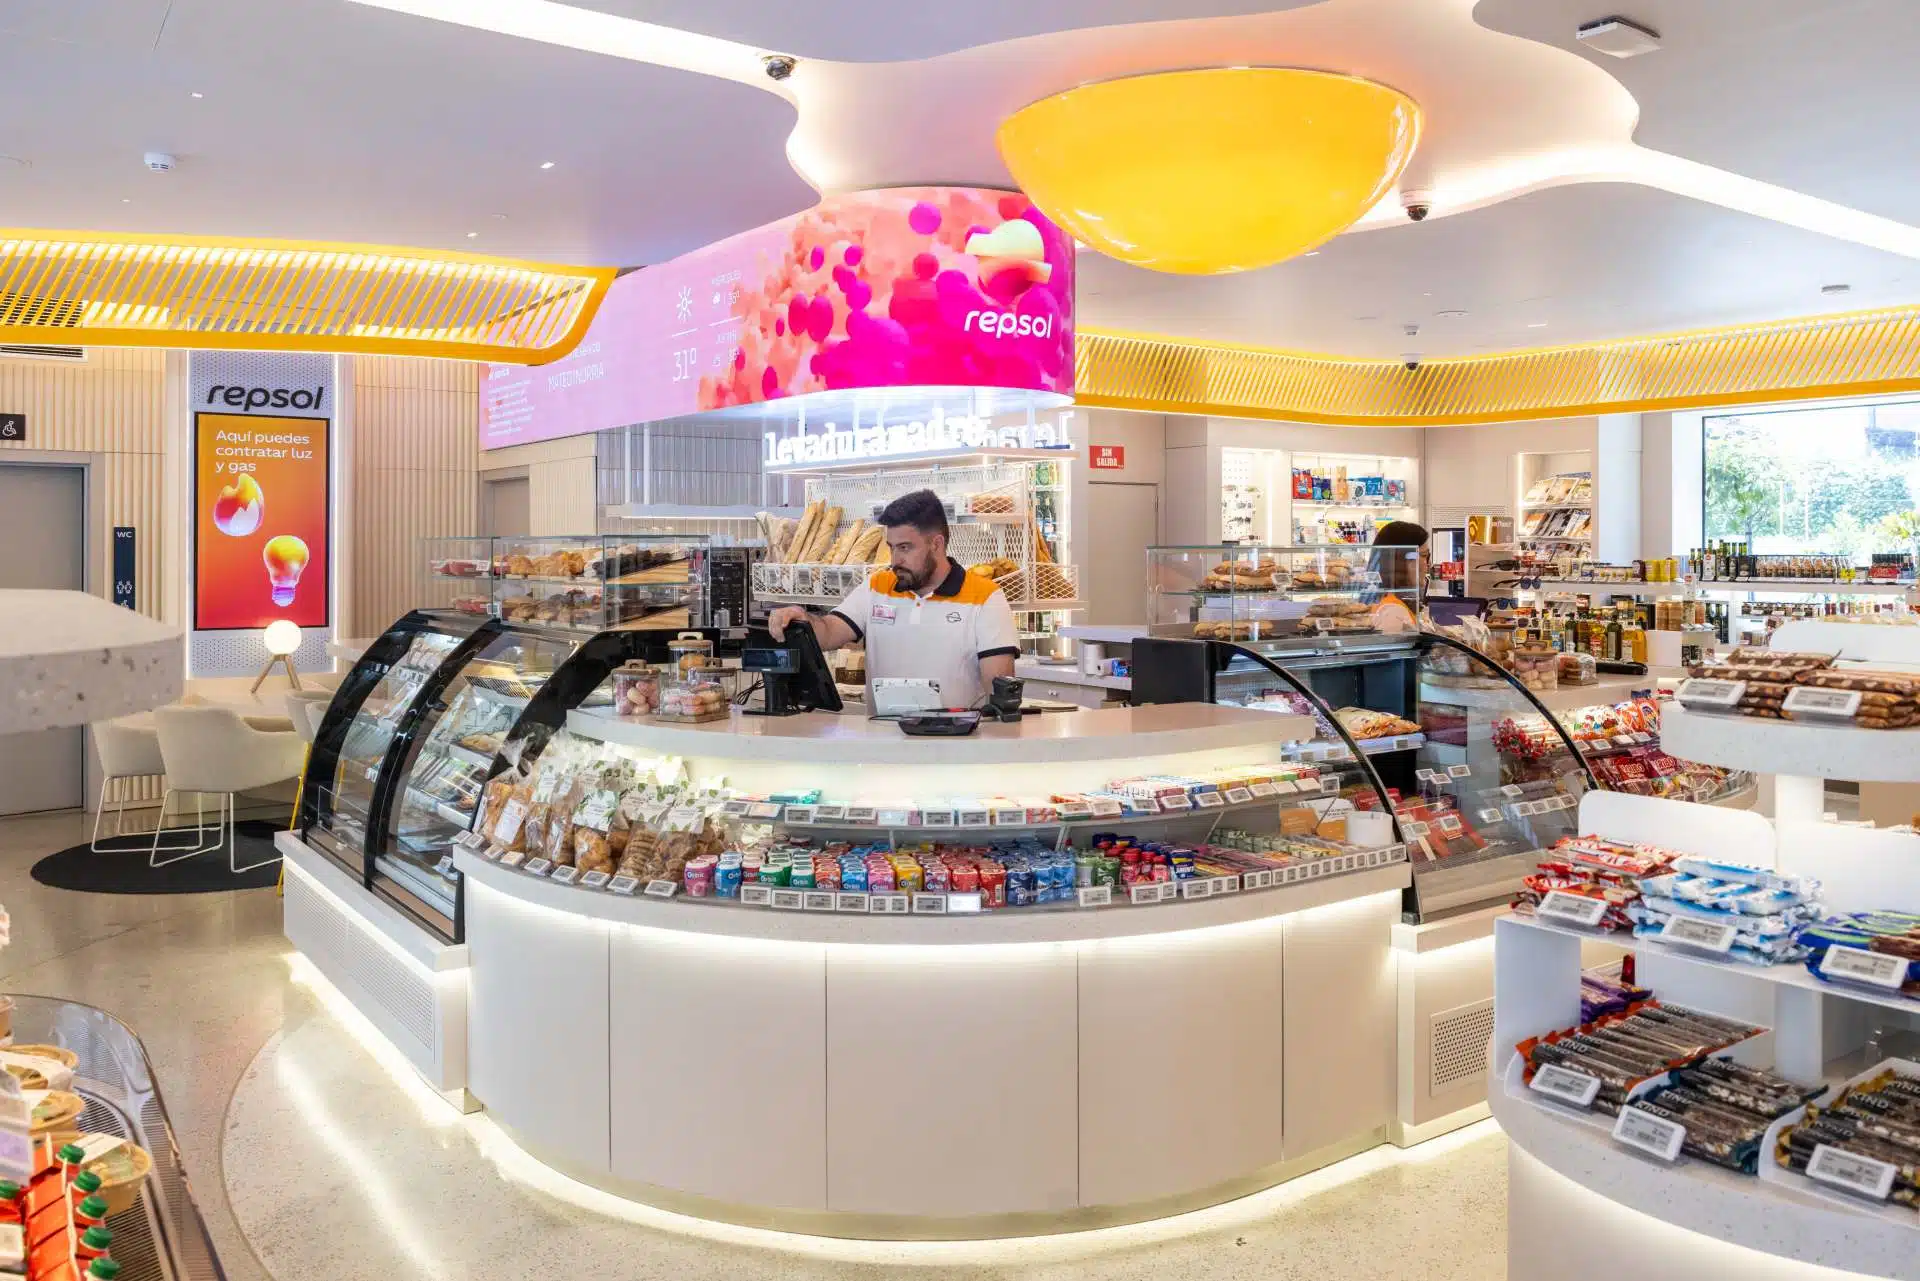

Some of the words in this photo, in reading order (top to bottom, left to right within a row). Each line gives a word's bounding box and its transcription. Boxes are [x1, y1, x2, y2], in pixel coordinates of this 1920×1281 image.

[964, 310, 1053, 339] repsol
[207, 385, 324, 411] repsol
[216, 430, 252, 443] Aquí
[254, 433, 311, 444] puedes
[216, 446, 288, 458] contratar
[291, 447, 313, 459] luz
[1101, 448, 1113, 457] SIN
[215, 462, 225, 473] y
[228, 463, 257, 474] gas
[1096, 457, 1118, 467] SALIDA
[1557, 1038, 1590, 1053] KIND
[1704, 1058, 1739, 1071] KIND
[1660, 1090, 1693, 1105] KIND
[1635, 1101, 1672, 1118] KIND
